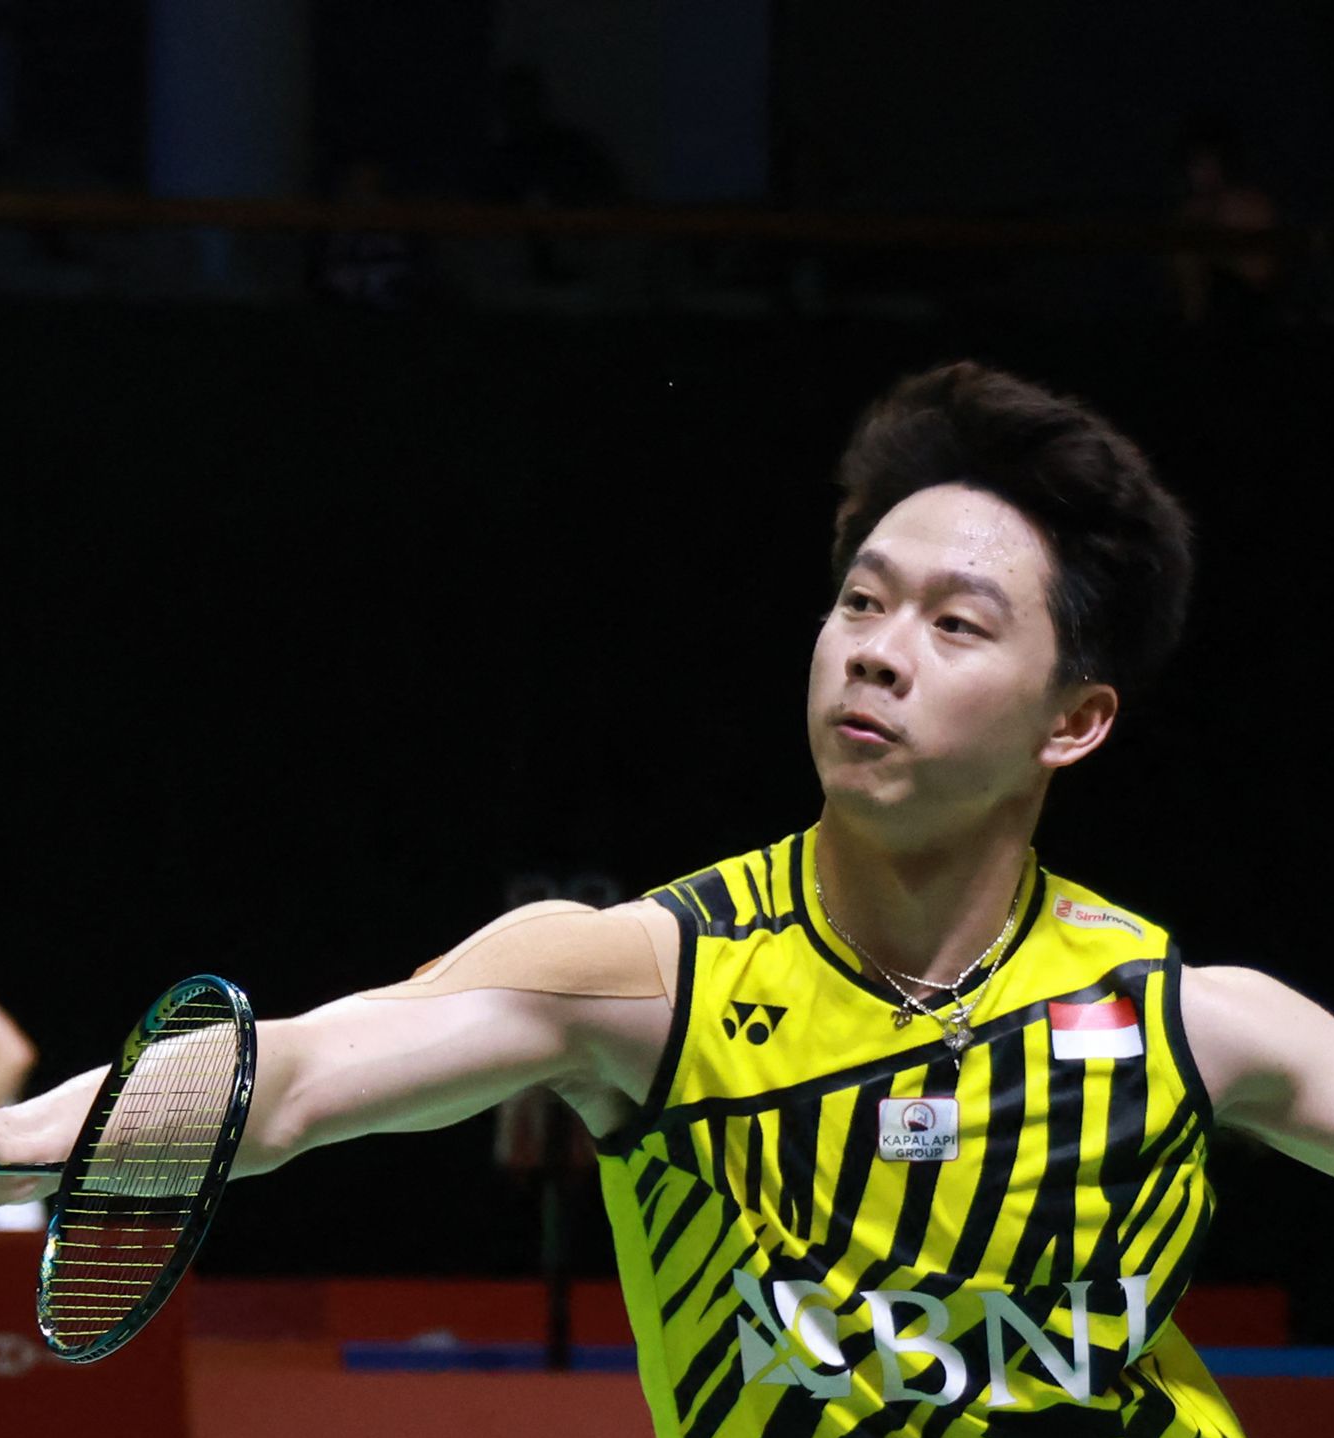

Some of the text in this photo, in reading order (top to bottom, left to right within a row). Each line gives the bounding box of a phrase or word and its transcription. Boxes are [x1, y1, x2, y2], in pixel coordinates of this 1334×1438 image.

[882, 1135, 956, 1146] KAPAL API
[895, 1148, 944, 1158] GROUP
[860, 1272, 1151, 1406] BNI
